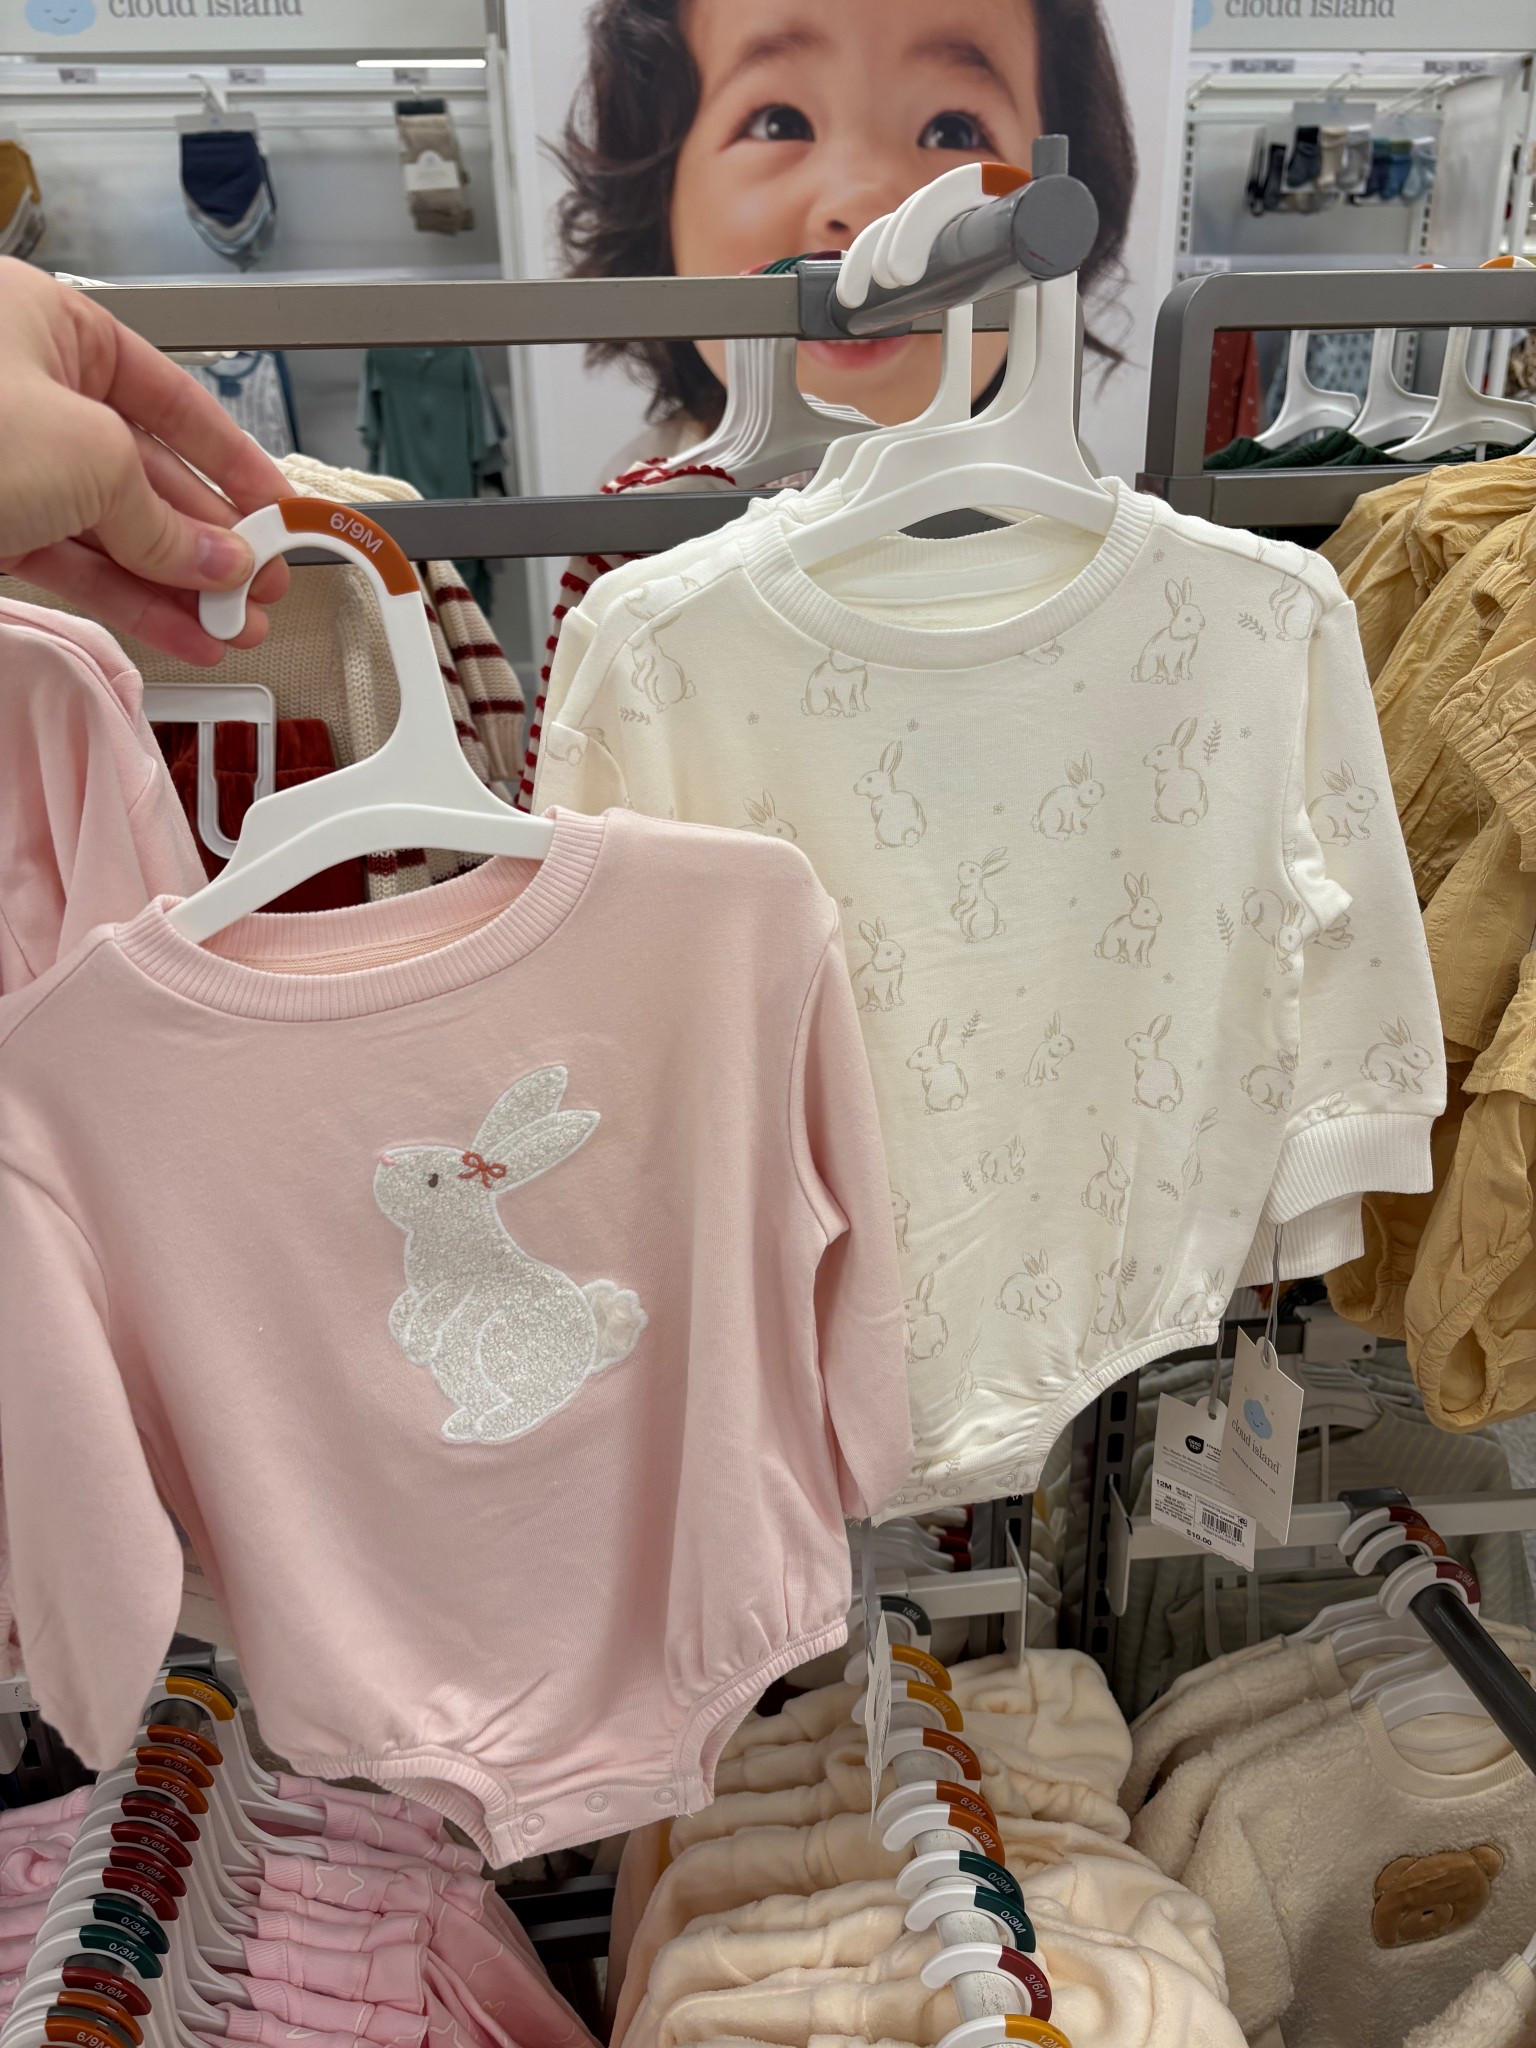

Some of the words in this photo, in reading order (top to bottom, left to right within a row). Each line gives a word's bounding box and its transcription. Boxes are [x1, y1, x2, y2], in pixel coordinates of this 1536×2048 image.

[330, 512, 383, 553] 6/9M
[1231, 1419, 1252, 1449] cloud
[1251, 1440, 1281, 1475] island
[1156, 1479, 1172, 1491] 12M
[1186, 1528, 1212, 1546] $10.00
[1456, 1570, 1475, 1588] 3/6M
[902, 1606, 919, 1621] 18M
[918, 1660, 939, 1677] 12M
[191, 1688, 213, 1703] 12M
[932, 1697, 951, 1714] 12M
[173, 1737, 203, 1754] 6/9M
[946, 1744, 970, 1764] 6/9M
[163, 1758, 193, 1775] 6/9M
[161, 1781, 190, 1800] 6/9M
[960, 1797, 986, 1817] 6/9M
[149, 1811, 179, 1830] 3/6M
[140, 1836, 170, 1855] 3/6M
[972, 1826, 996, 1850] 6/9M
[135, 1863, 166, 1882] 3/6M
[987, 1872, 1014, 1895] 0/3M
[130, 1884, 160, 1905] 3/6M
[120, 1916, 150, 1938] 0/3M
[1000, 1910, 1026, 1935] 0/3M
[108, 1942, 140, 1963] 0/3M
[94, 1982, 128, 2000] 3/6M
[1024, 1973, 1048, 2000] 3/6M
